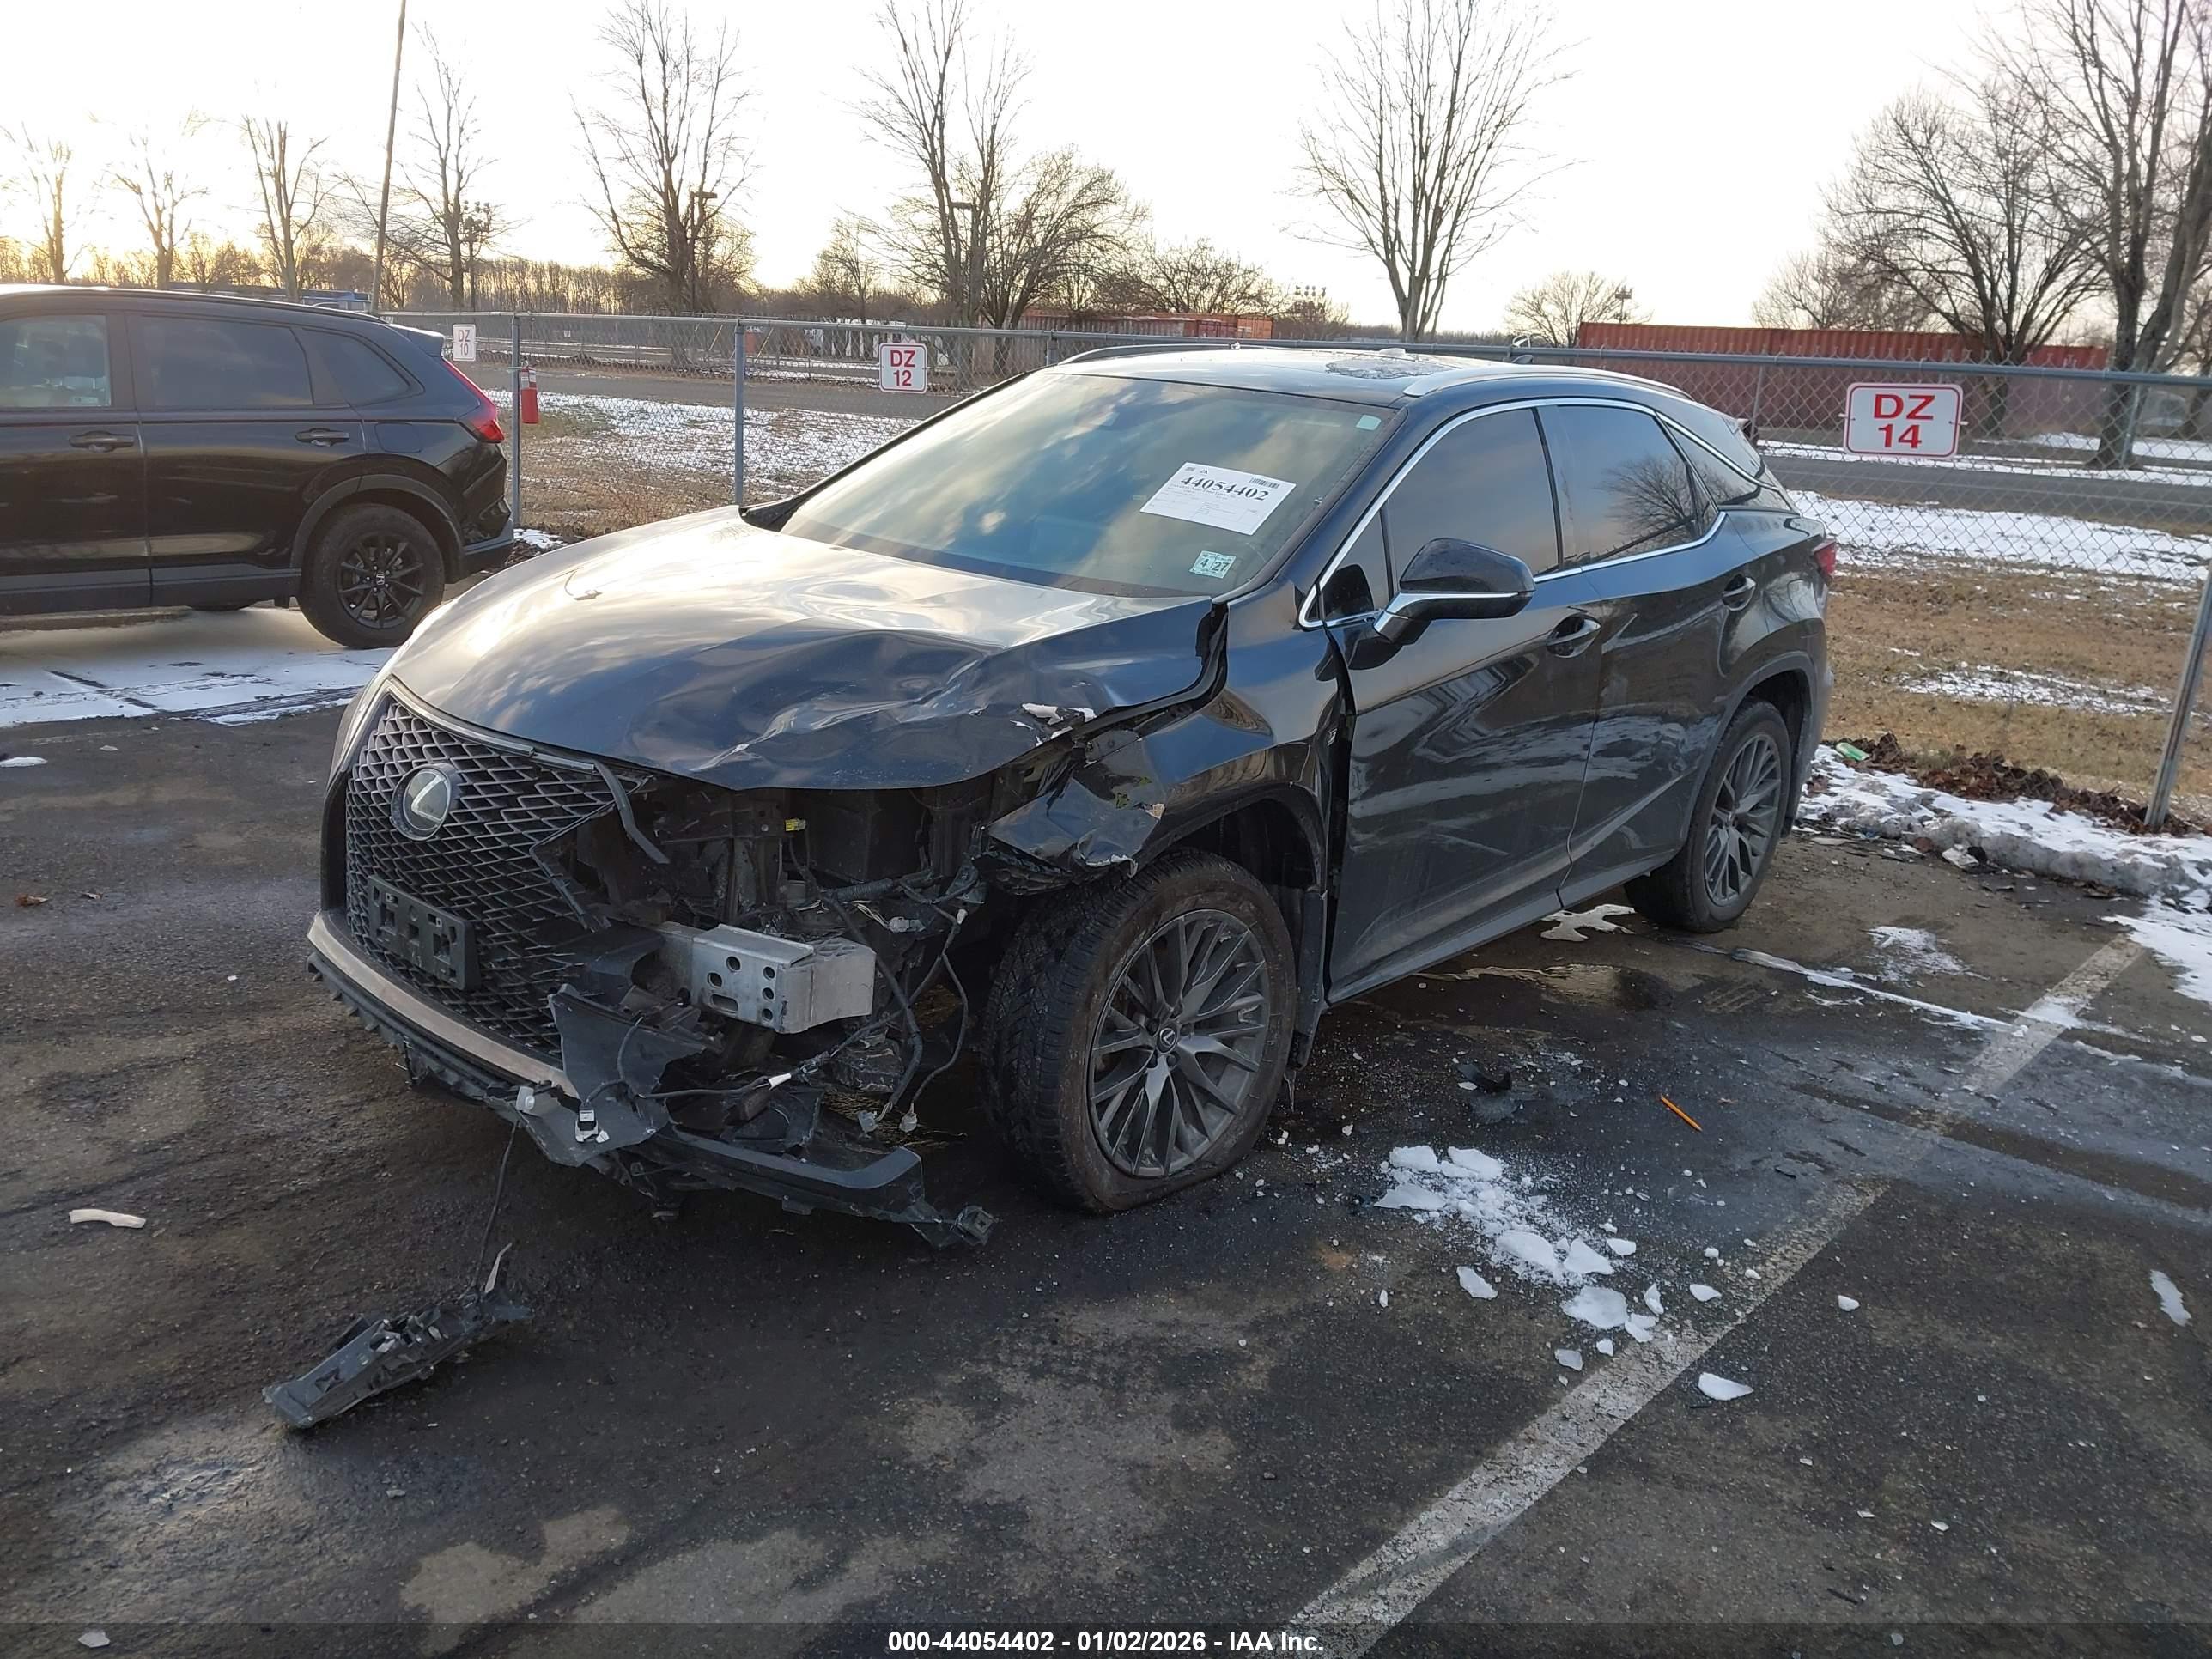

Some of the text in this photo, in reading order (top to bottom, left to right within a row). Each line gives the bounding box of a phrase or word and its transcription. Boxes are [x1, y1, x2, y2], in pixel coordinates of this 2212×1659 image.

[458, 330, 471, 343] DZ
[459, 343, 469, 356] 10
[890, 349, 916, 368] DZ
[893, 369, 912, 386] 12
[1874, 393, 1936, 420] DZ
[1878, 423, 1923, 449] 14
[1180, 475, 1270, 501] 44054402
[1200, 558, 1210, 568] 4
[1212, 561, 1231, 572] 27
